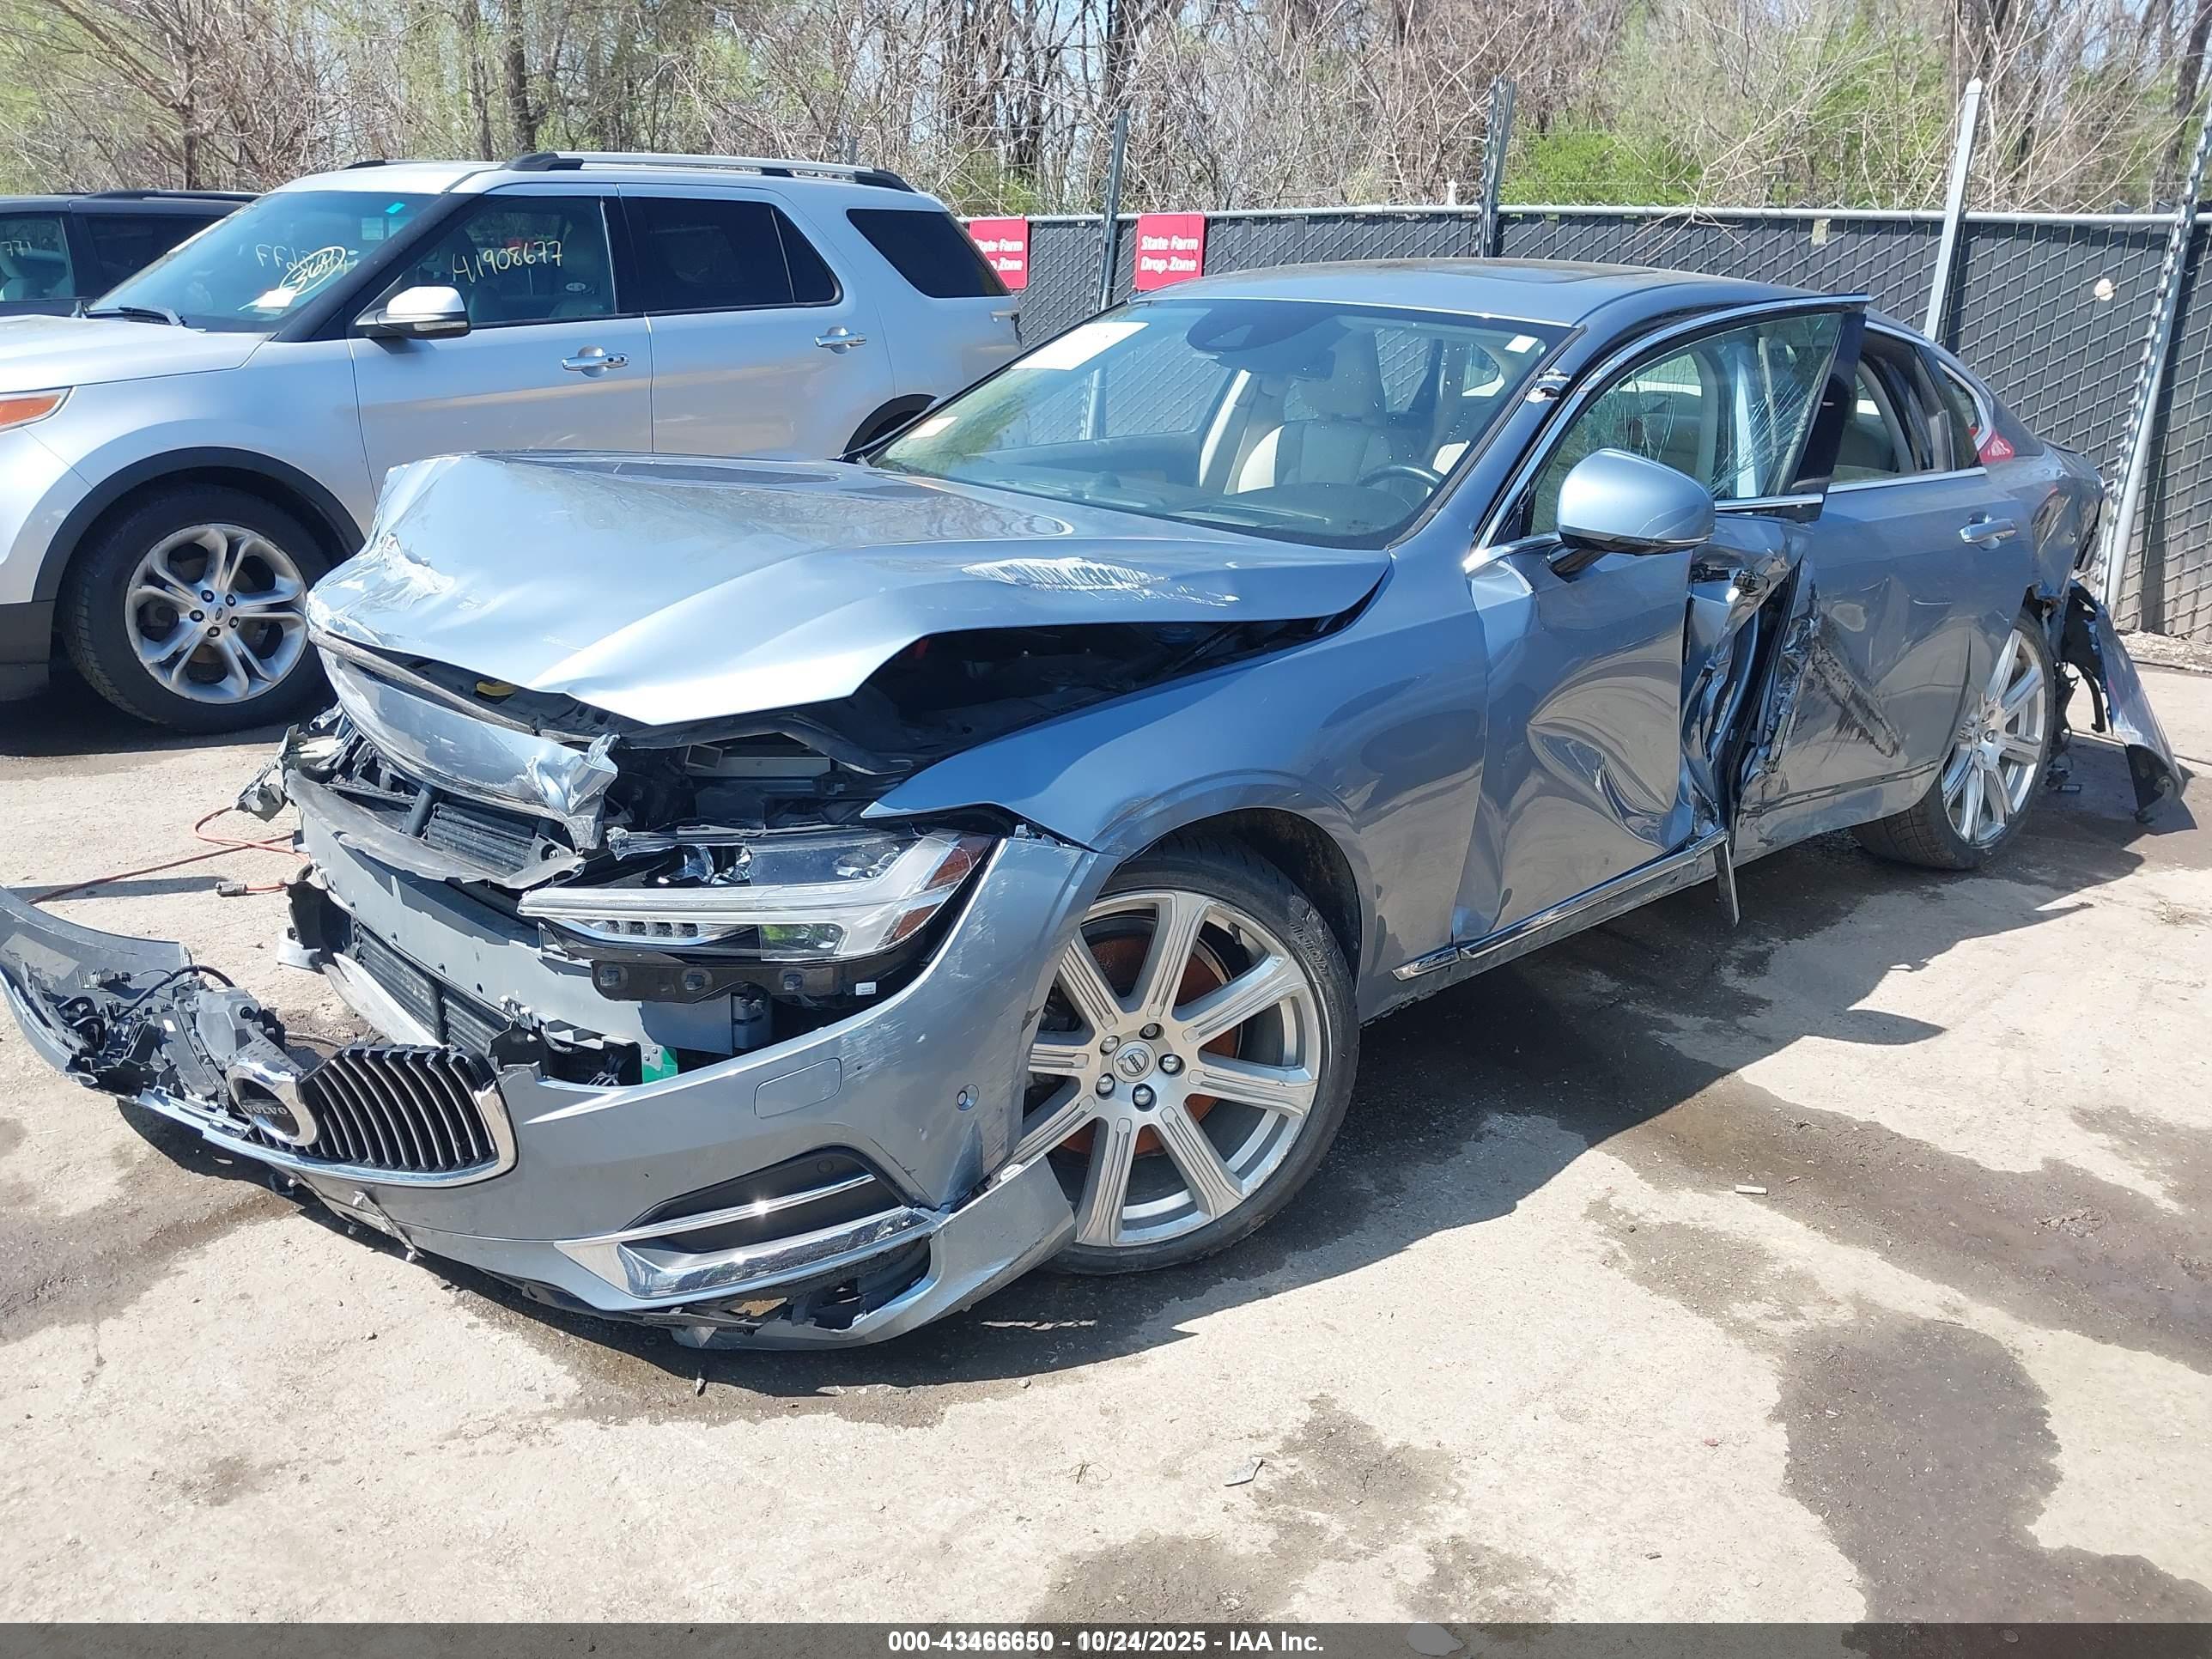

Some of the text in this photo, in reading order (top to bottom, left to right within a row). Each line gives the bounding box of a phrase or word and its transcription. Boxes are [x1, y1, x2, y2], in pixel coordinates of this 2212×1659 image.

[1000, 238, 1024, 252] Farm
[1140, 234, 1199, 251] State Farm
[453, 240, 562, 283] 41908677
[999, 257, 1023, 271] Zone
[1140, 256, 1197, 275] Drop Zone
[241, 1104, 288, 1115] VOLVO
